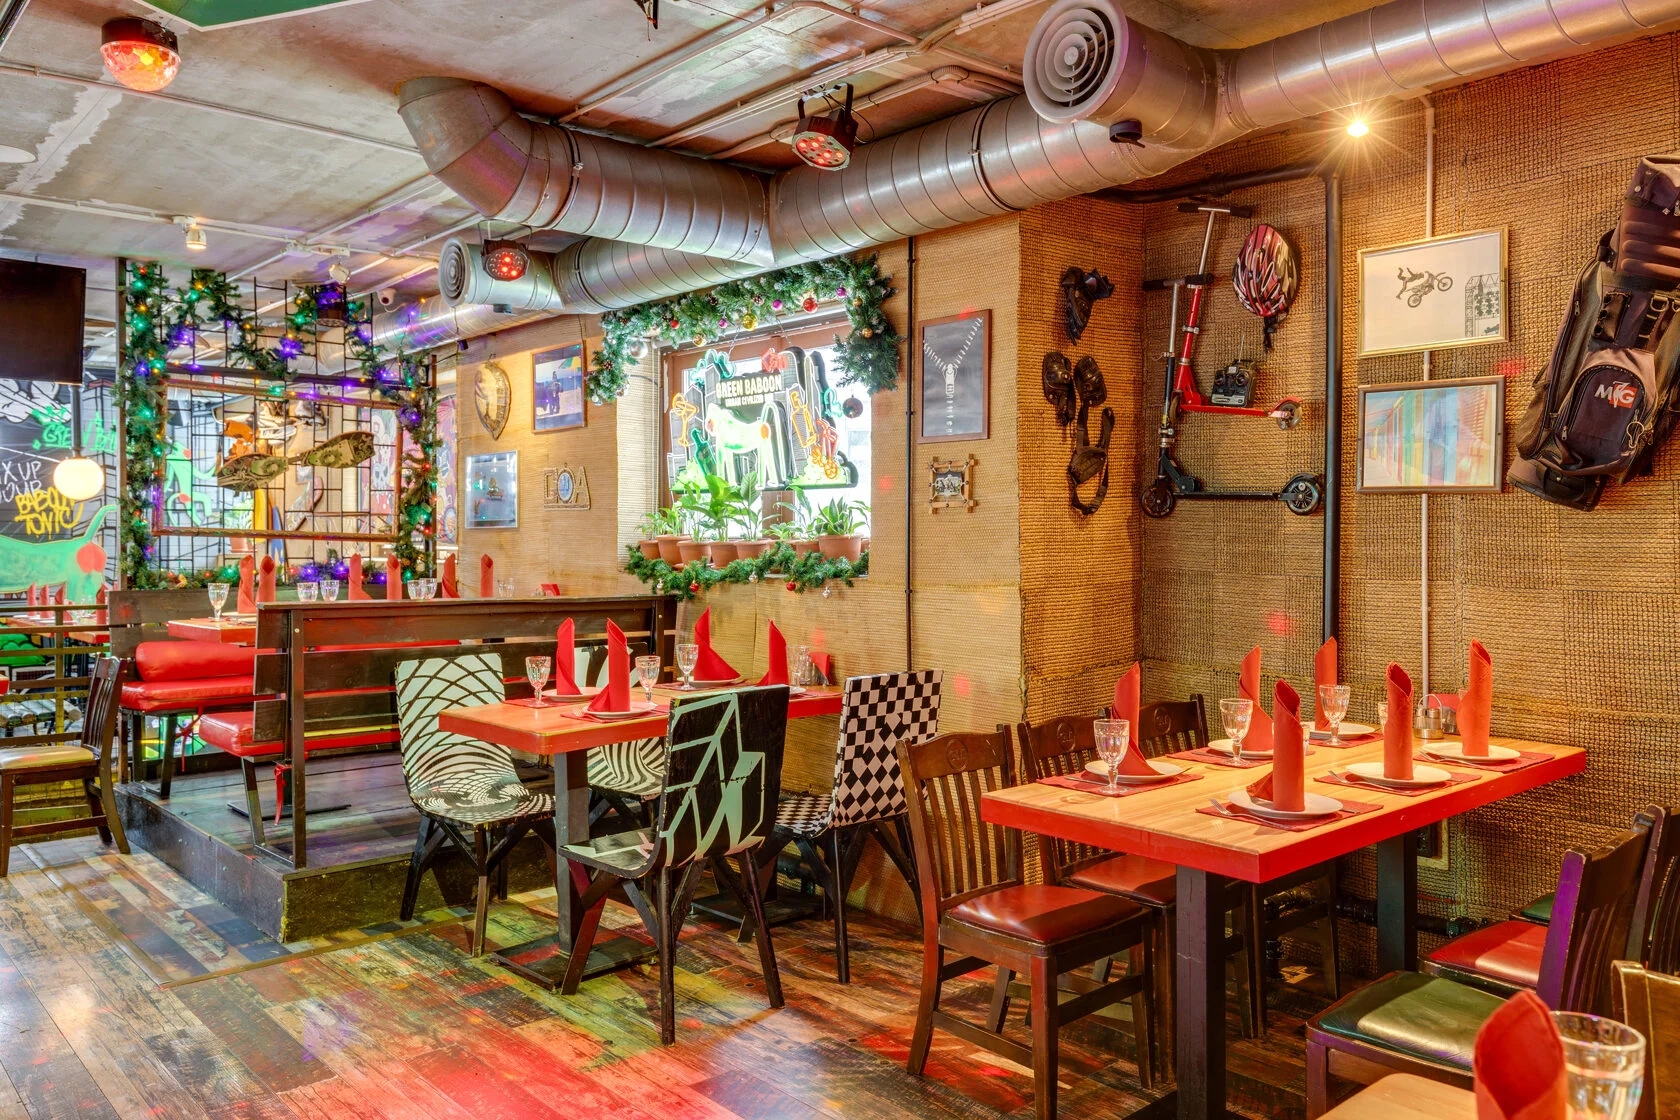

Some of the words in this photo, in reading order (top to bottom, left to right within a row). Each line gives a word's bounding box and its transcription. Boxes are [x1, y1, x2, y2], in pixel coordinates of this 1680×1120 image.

[715, 380, 743, 398] GREEN
[745, 375, 782, 394] BABOON
[18, 461, 42, 481] UP
[0, 480, 48, 503] OUR
[14, 504, 84, 537] TONIC
